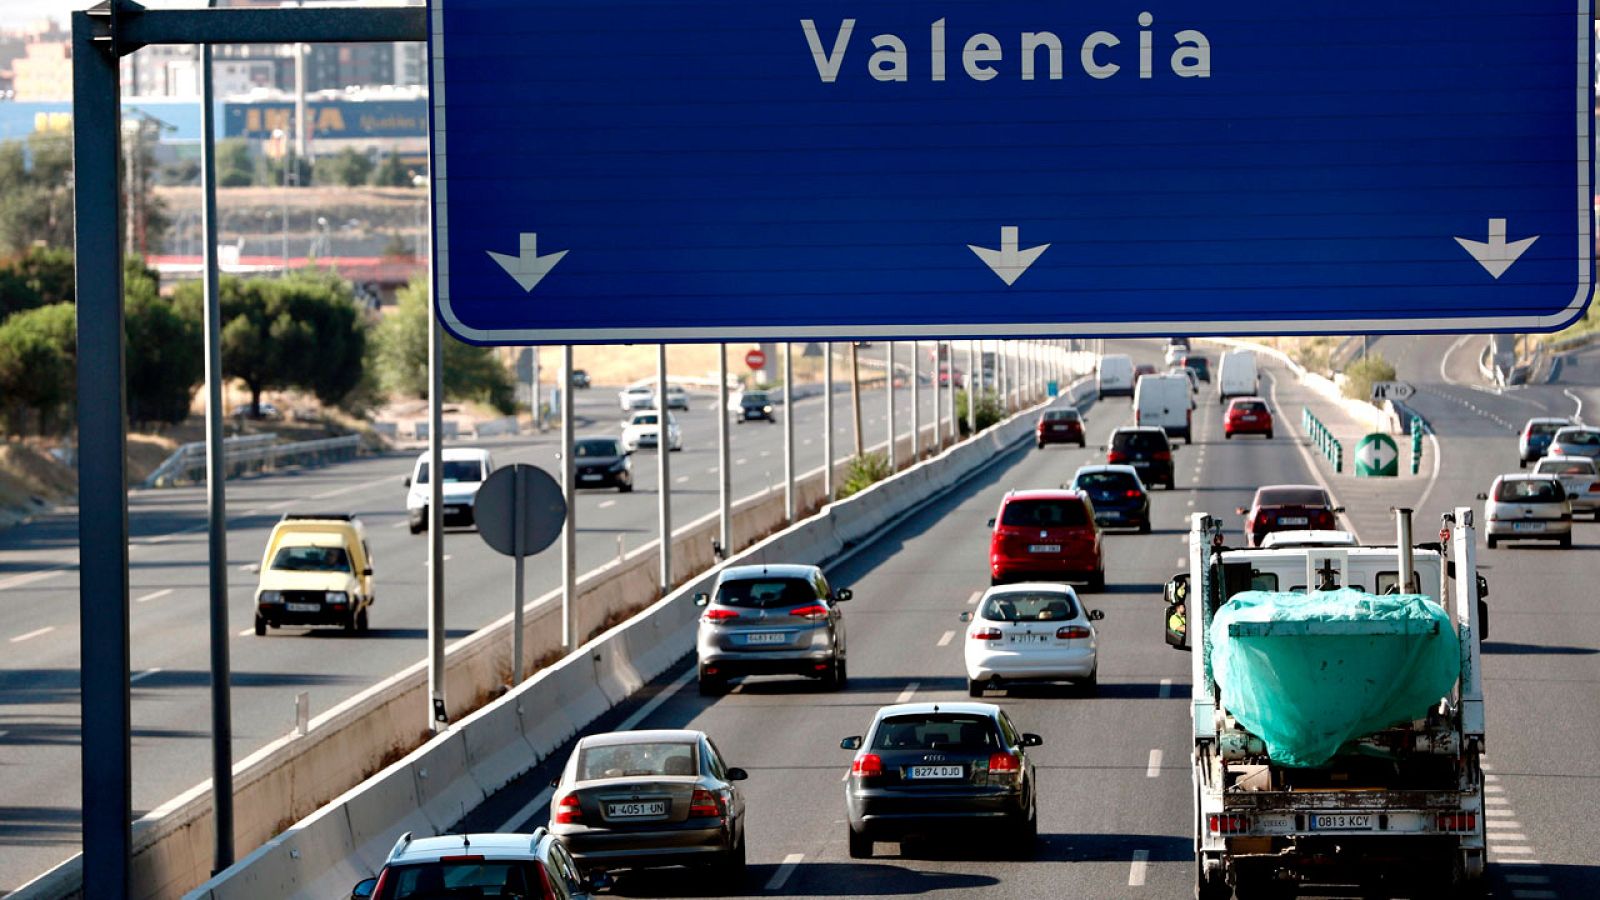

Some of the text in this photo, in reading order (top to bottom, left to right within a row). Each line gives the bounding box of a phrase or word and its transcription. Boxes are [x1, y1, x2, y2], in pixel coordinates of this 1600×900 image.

[800, 11, 1211, 83] Valencia
[914, 767, 939, 777] 8274
[1318, 815, 1370, 827] 0813 KCY
